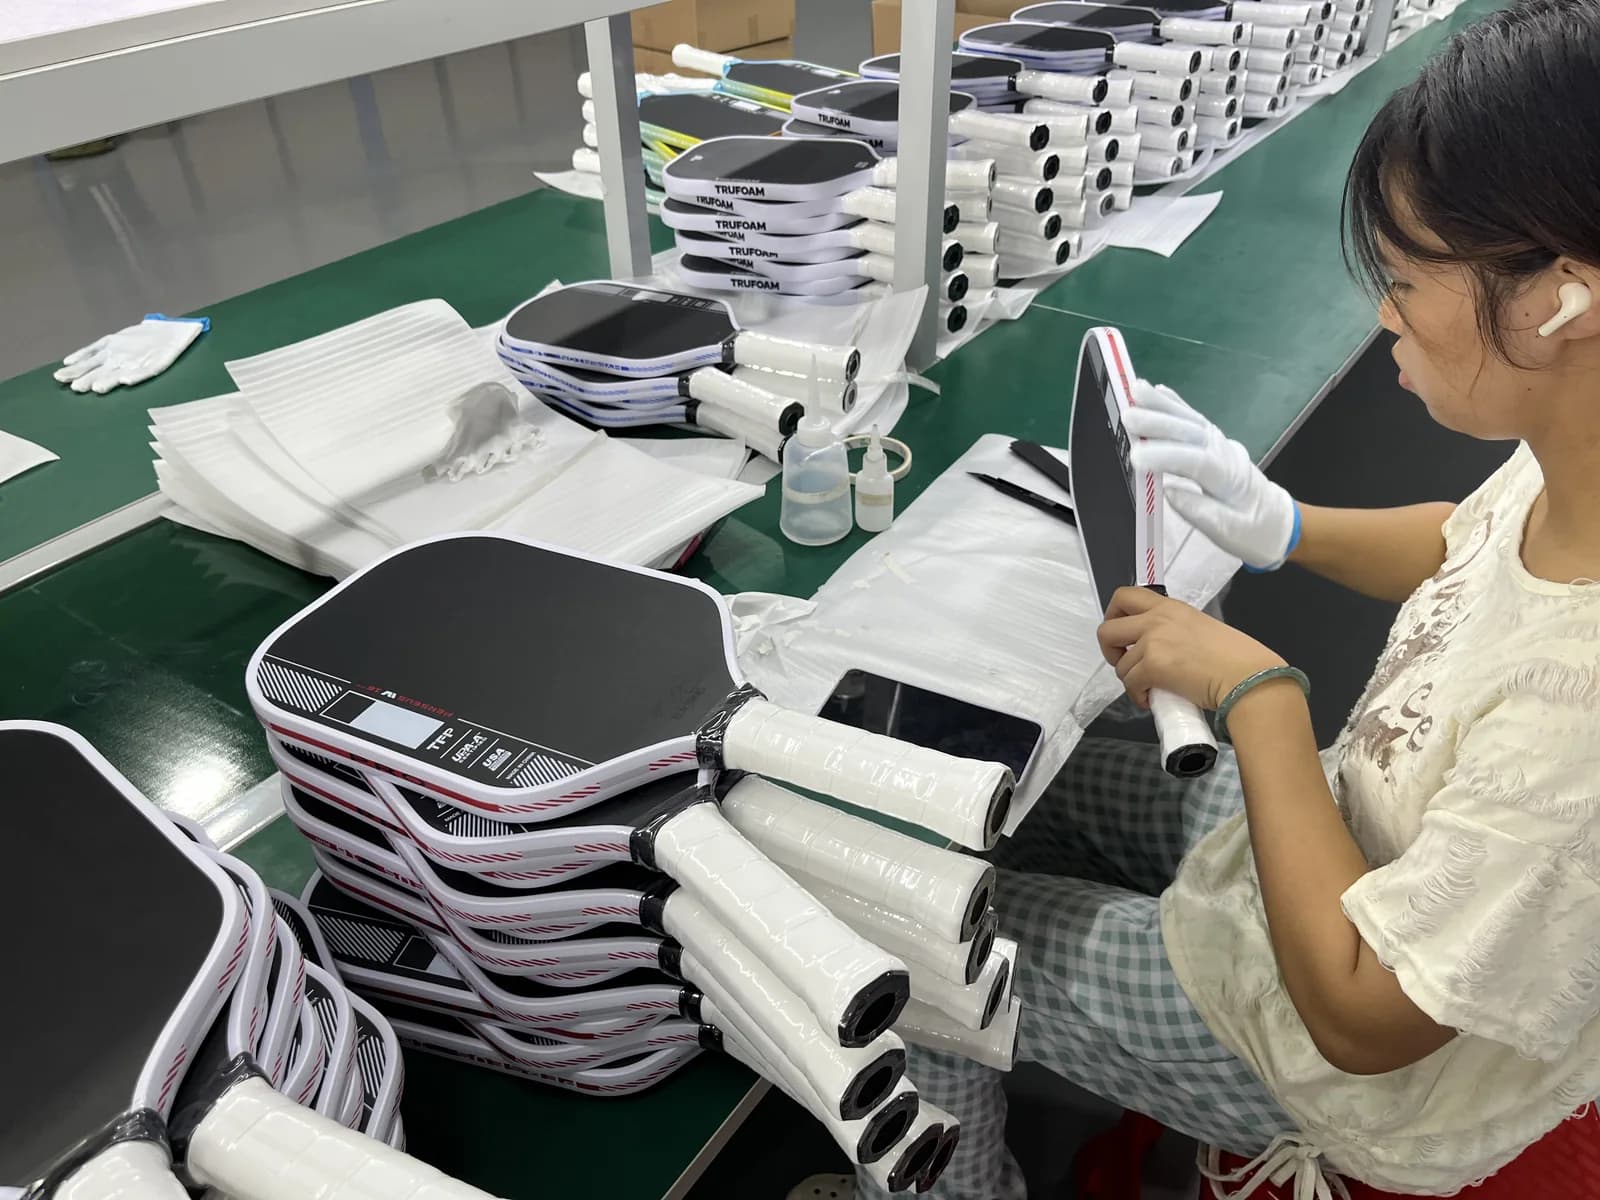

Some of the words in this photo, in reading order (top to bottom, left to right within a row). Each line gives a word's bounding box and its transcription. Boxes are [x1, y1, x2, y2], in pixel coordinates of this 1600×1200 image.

[818, 113, 851, 129] TRUFOAM
[714, 185, 765, 197] TRUFOAM
[695, 195, 734, 211] TRUFOAM
[715, 220, 767, 232] TRUFOAM
[730, 278, 780, 290] TRUFOAM
[426, 727, 454, 751] TFP
[482, 748, 506, 768] USA
